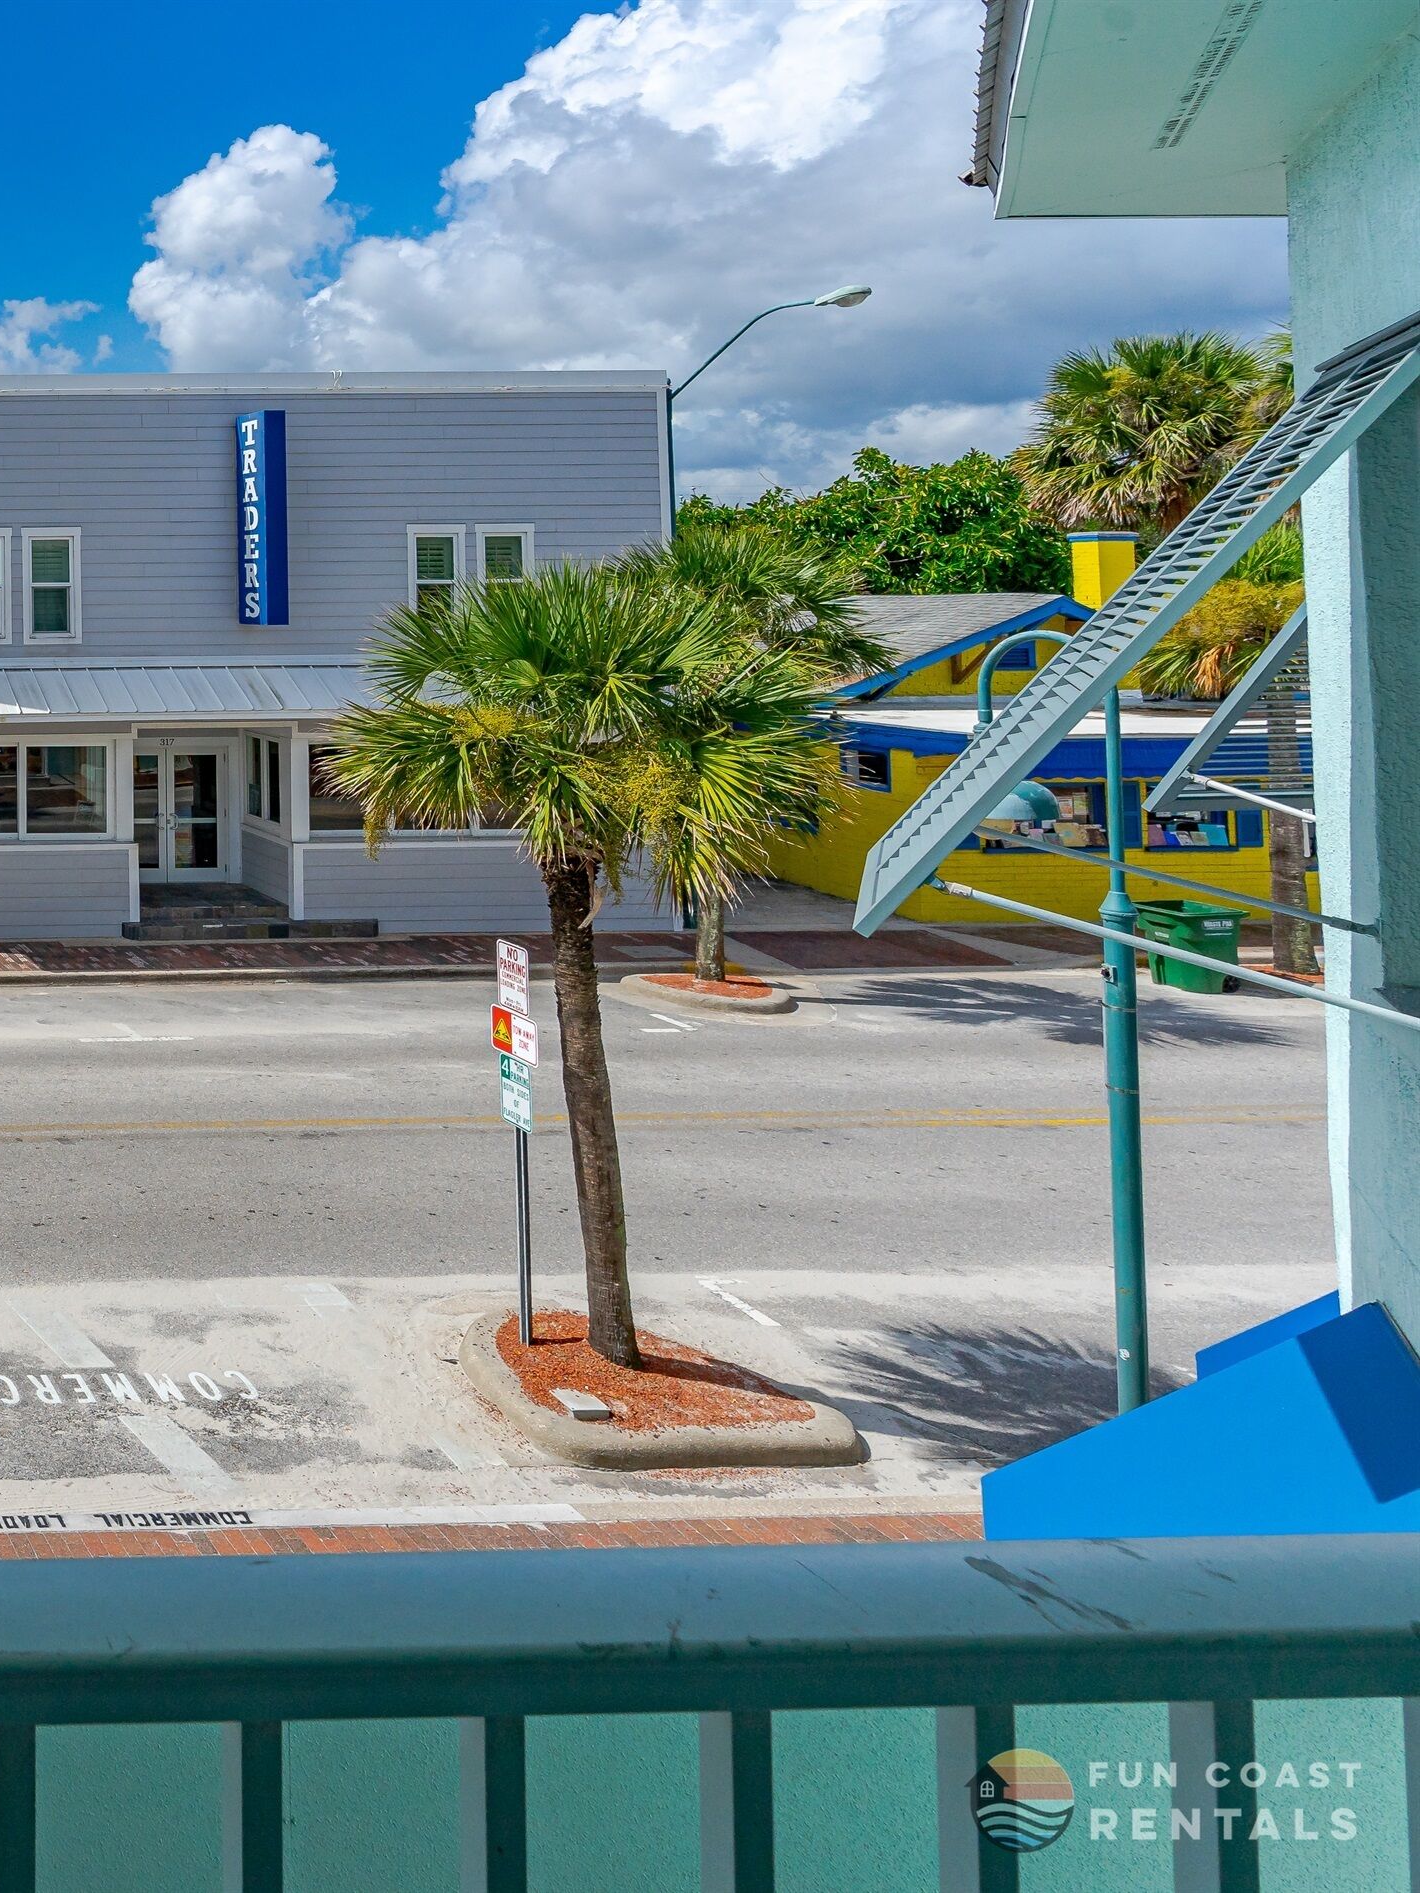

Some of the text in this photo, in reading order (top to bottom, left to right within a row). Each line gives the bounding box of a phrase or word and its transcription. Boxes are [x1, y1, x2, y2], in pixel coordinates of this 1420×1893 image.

[241, 419, 261, 619] TRADERS
[159, 738, 175, 747] 317
[506, 946, 518, 961] NO
[499, 957, 526, 979] PARKING
[501, 971, 525, 986] COMMERCIAL
[516, 983, 526, 994] ZONE
[512, 1024, 535, 1042] TOW AWAY
[518, 1038, 529, 1052] ZONE
[501, 1058, 510, 1075] 4
[510, 1071, 529, 1085] PARKING
[503, 1082, 529, 1101] BOTH SIDES
[513, 1099, 520, 1108] OF
[503, 1106, 530, 1127] FLAGLER AVE
[93, 1510, 253, 1525] COMMERCIAL
